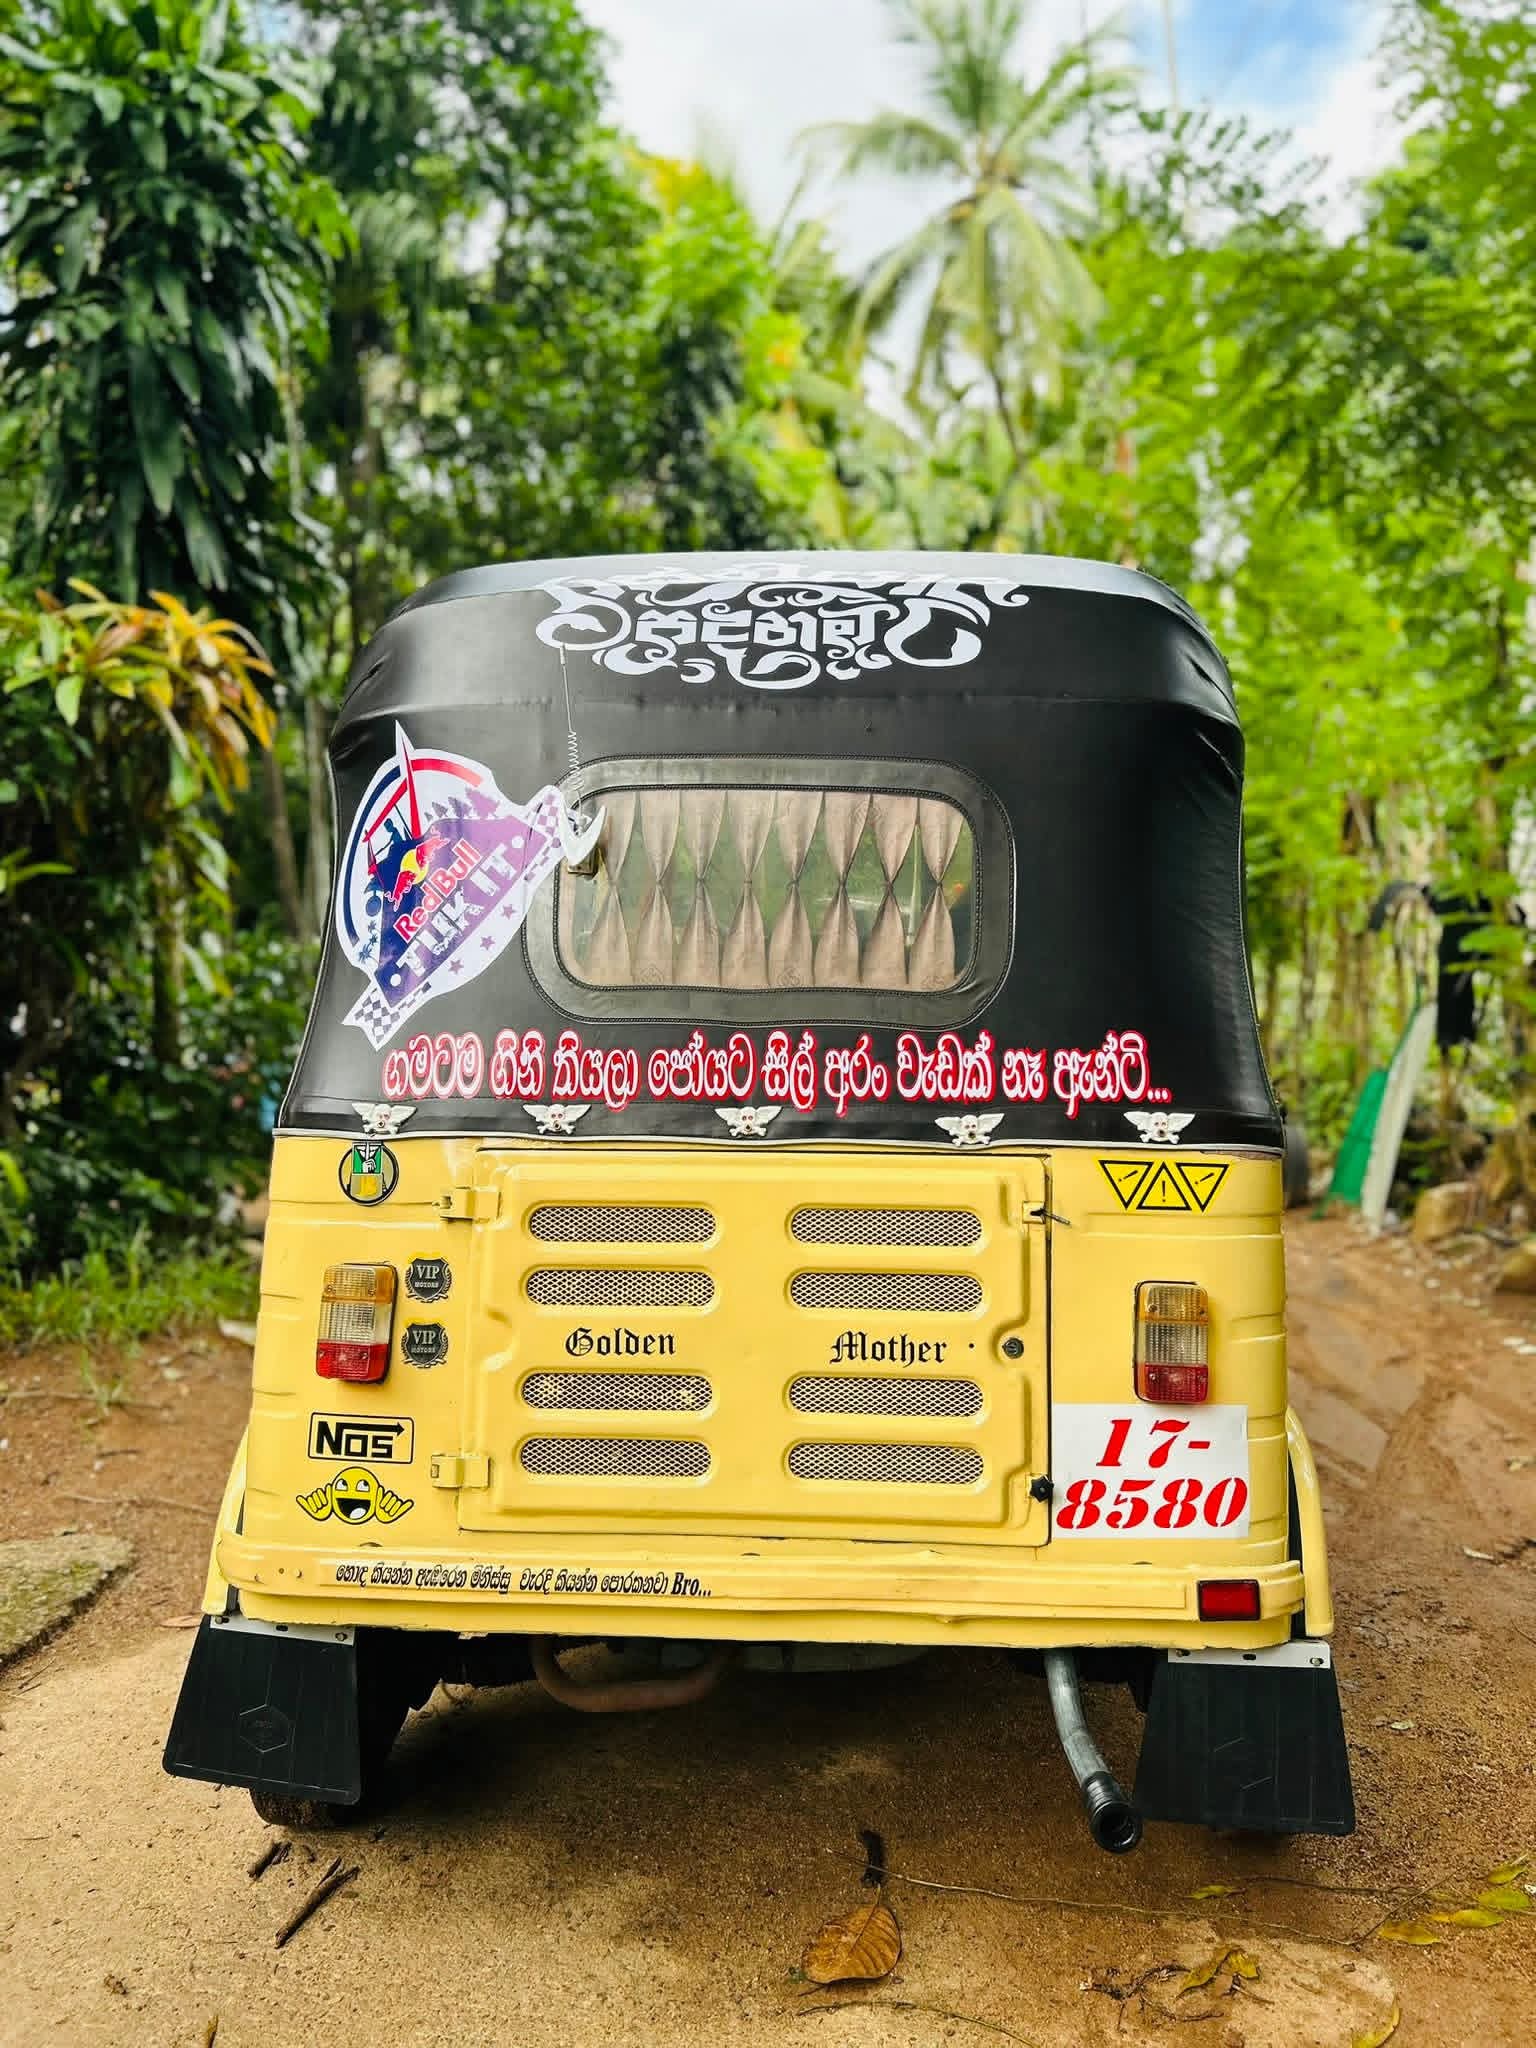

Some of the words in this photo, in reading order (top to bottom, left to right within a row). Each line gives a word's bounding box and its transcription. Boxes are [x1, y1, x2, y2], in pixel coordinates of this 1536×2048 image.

[416, 1265, 440, 1279] VIP
[412, 1330, 436, 1345] VIP
[565, 1327, 677, 1357] Golden
[829, 1330, 948, 1368] Mother
[1056, 1477, 1248, 1530] 8580
[671, 1572, 712, 1598] Bro...
